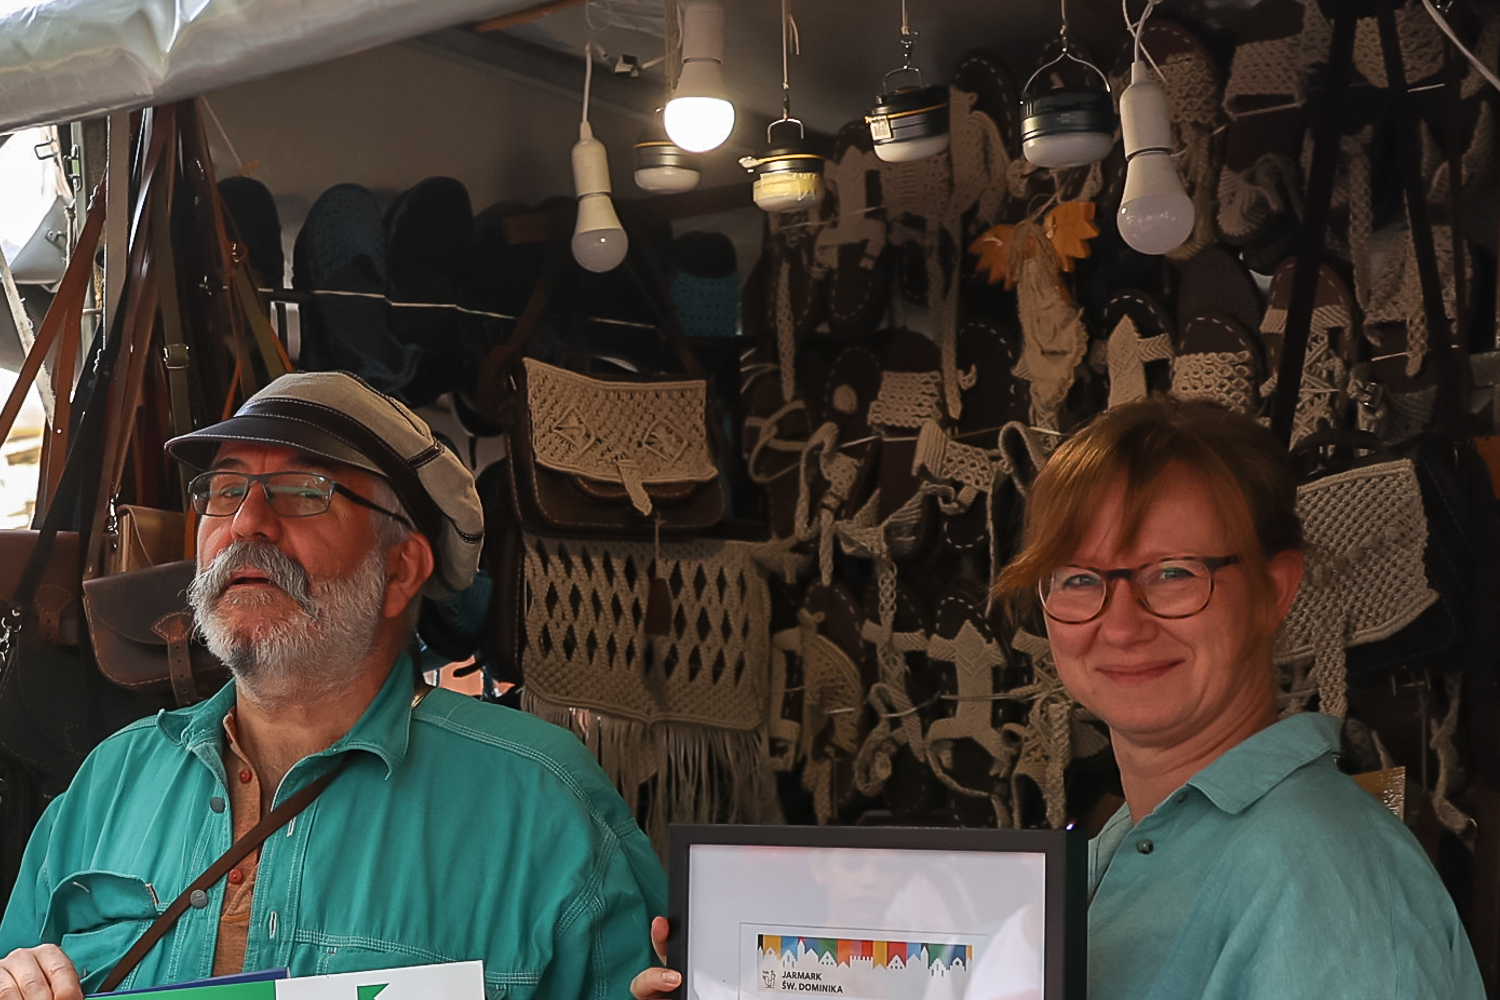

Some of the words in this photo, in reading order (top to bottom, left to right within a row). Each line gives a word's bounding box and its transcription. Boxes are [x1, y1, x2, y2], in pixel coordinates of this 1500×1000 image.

[781, 970, 822, 982] JARMARK
[781, 980, 797, 991] ŚW.
[798, 983, 843, 994] DOMINIKA
